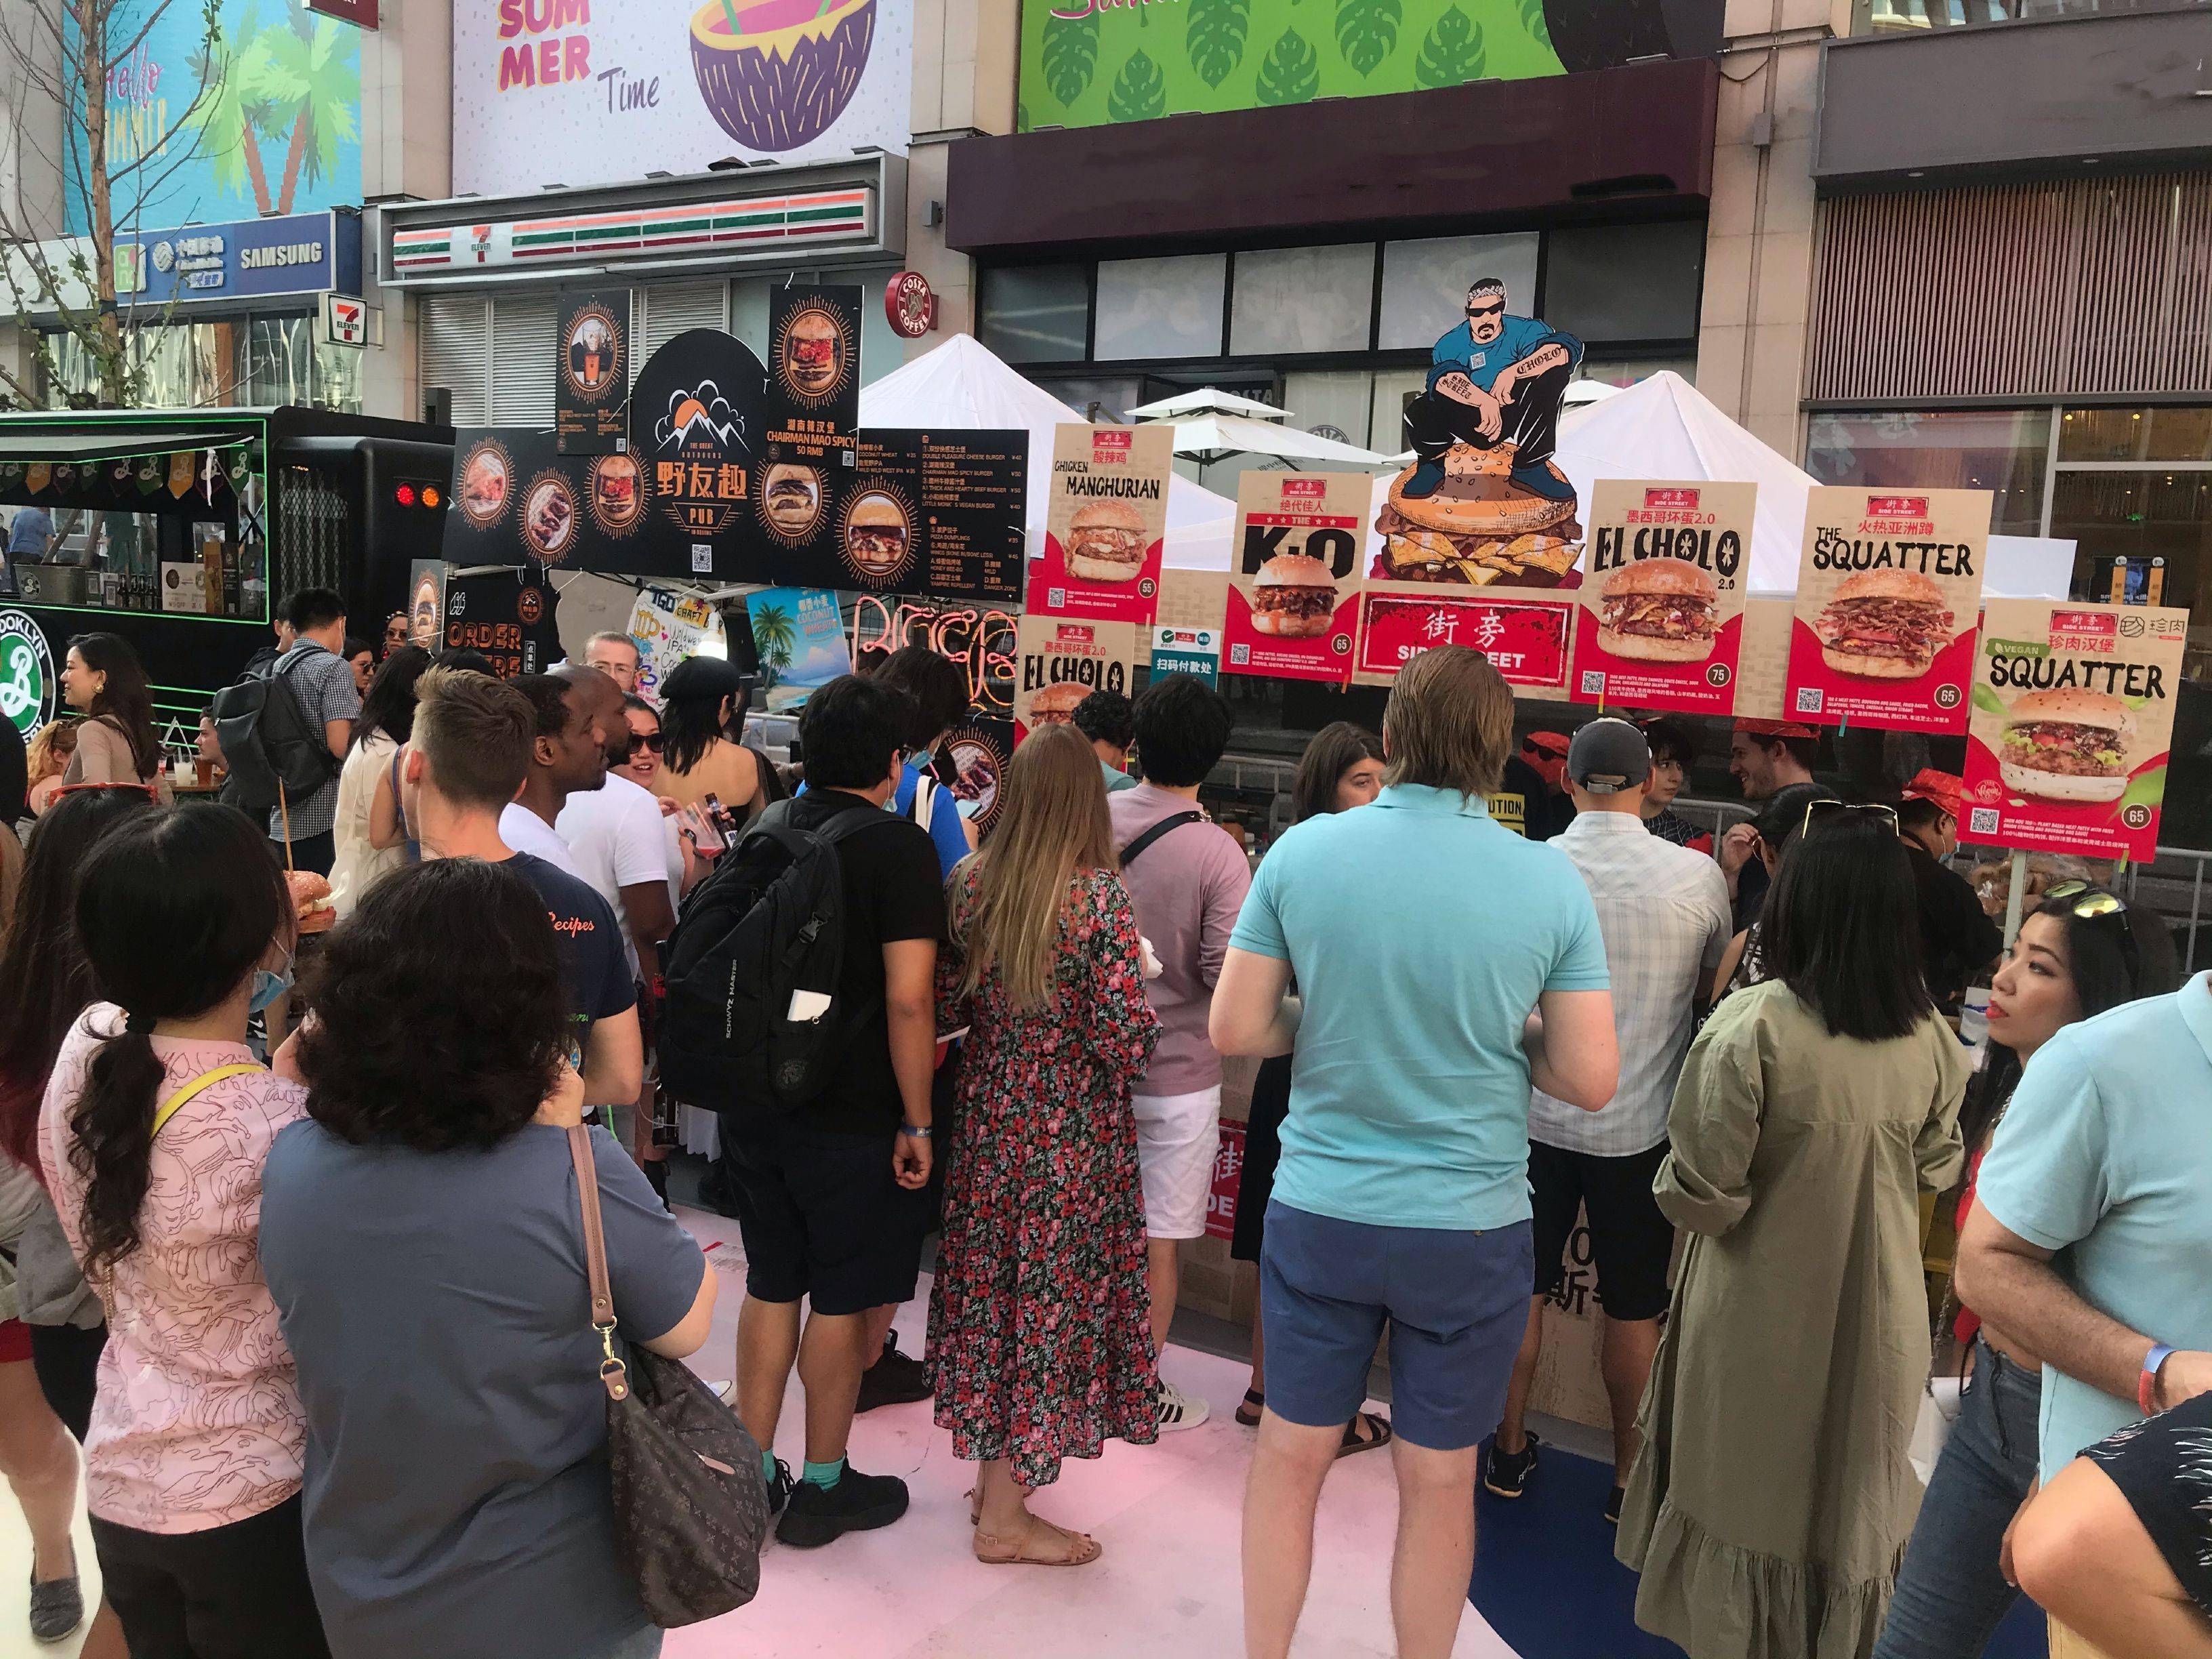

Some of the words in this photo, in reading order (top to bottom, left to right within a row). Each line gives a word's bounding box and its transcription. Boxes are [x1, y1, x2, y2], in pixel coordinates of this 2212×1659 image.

[497, 35, 591, 92] MER
[598, 66, 660, 115] Time
[241, 242, 323, 270] SAMSUNG
[903, 279, 926, 297] COSTA
[337, 304, 359, 341] 7
[901, 309, 928, 332] COFFEE
[767, 431, 810, 444] CHAIRMAN
[811, 434, 831, 445] MAO
[832, 436, 856, 447] SPICY
[797, 446, 805, 454] 50
[807, 447, 823, 456] RMB
[1093, 451, 1126, 464] 酸辣鸡
[1054, 460, 1088, 473] CHICKEN
[657, 462, 747, 499] 野友趣
[1279, 499, 1324, 512] 绝代佳人
[690, 508, 714, 524] PUB
[1292, 516, 1311, 525] THE
[1626, 510, 1715, 525] 墨西哥坏蛋2.0
[1816, 527, 1843, 541] THE
[1858, 520, 1934, 535] 火热亚洲蹲
[1594, 527, 1626, 572] EL
[1633, 527, 1741, 577] CHOLO
[1813, 540, 1973, 576] SQUATTER
[1142, 583, 1152, 593] 55
[1718, 579, 1735, 590] 2.0
[676, 607, 703, 622] CRAFT
[447, 621, 521, 650] ORDER
[1422, 608, 1505, 649] 街旁
[1044, 642, 1106, 656] 墨西哥坏蛋2.0
[1336, 638, 1347, 650] 65
[2003, 644, 2039, 655] VEGAN
[2049, 635, 2114, 653] 珍肉汉堡
[1024, 655, 1046, 692] EL
[1156, 658, 1212, 674] 扫码付款处
[1713, 669, 1725, 681] 75
[1990, 655, 2166, 699] SQUATTER
[1941, 690, 1954, 703] 65
[1488, 800, 1522, 815] UTION
[2129, 810, 2144, 822] 65
[729, 959, 737, 995] MASTER
